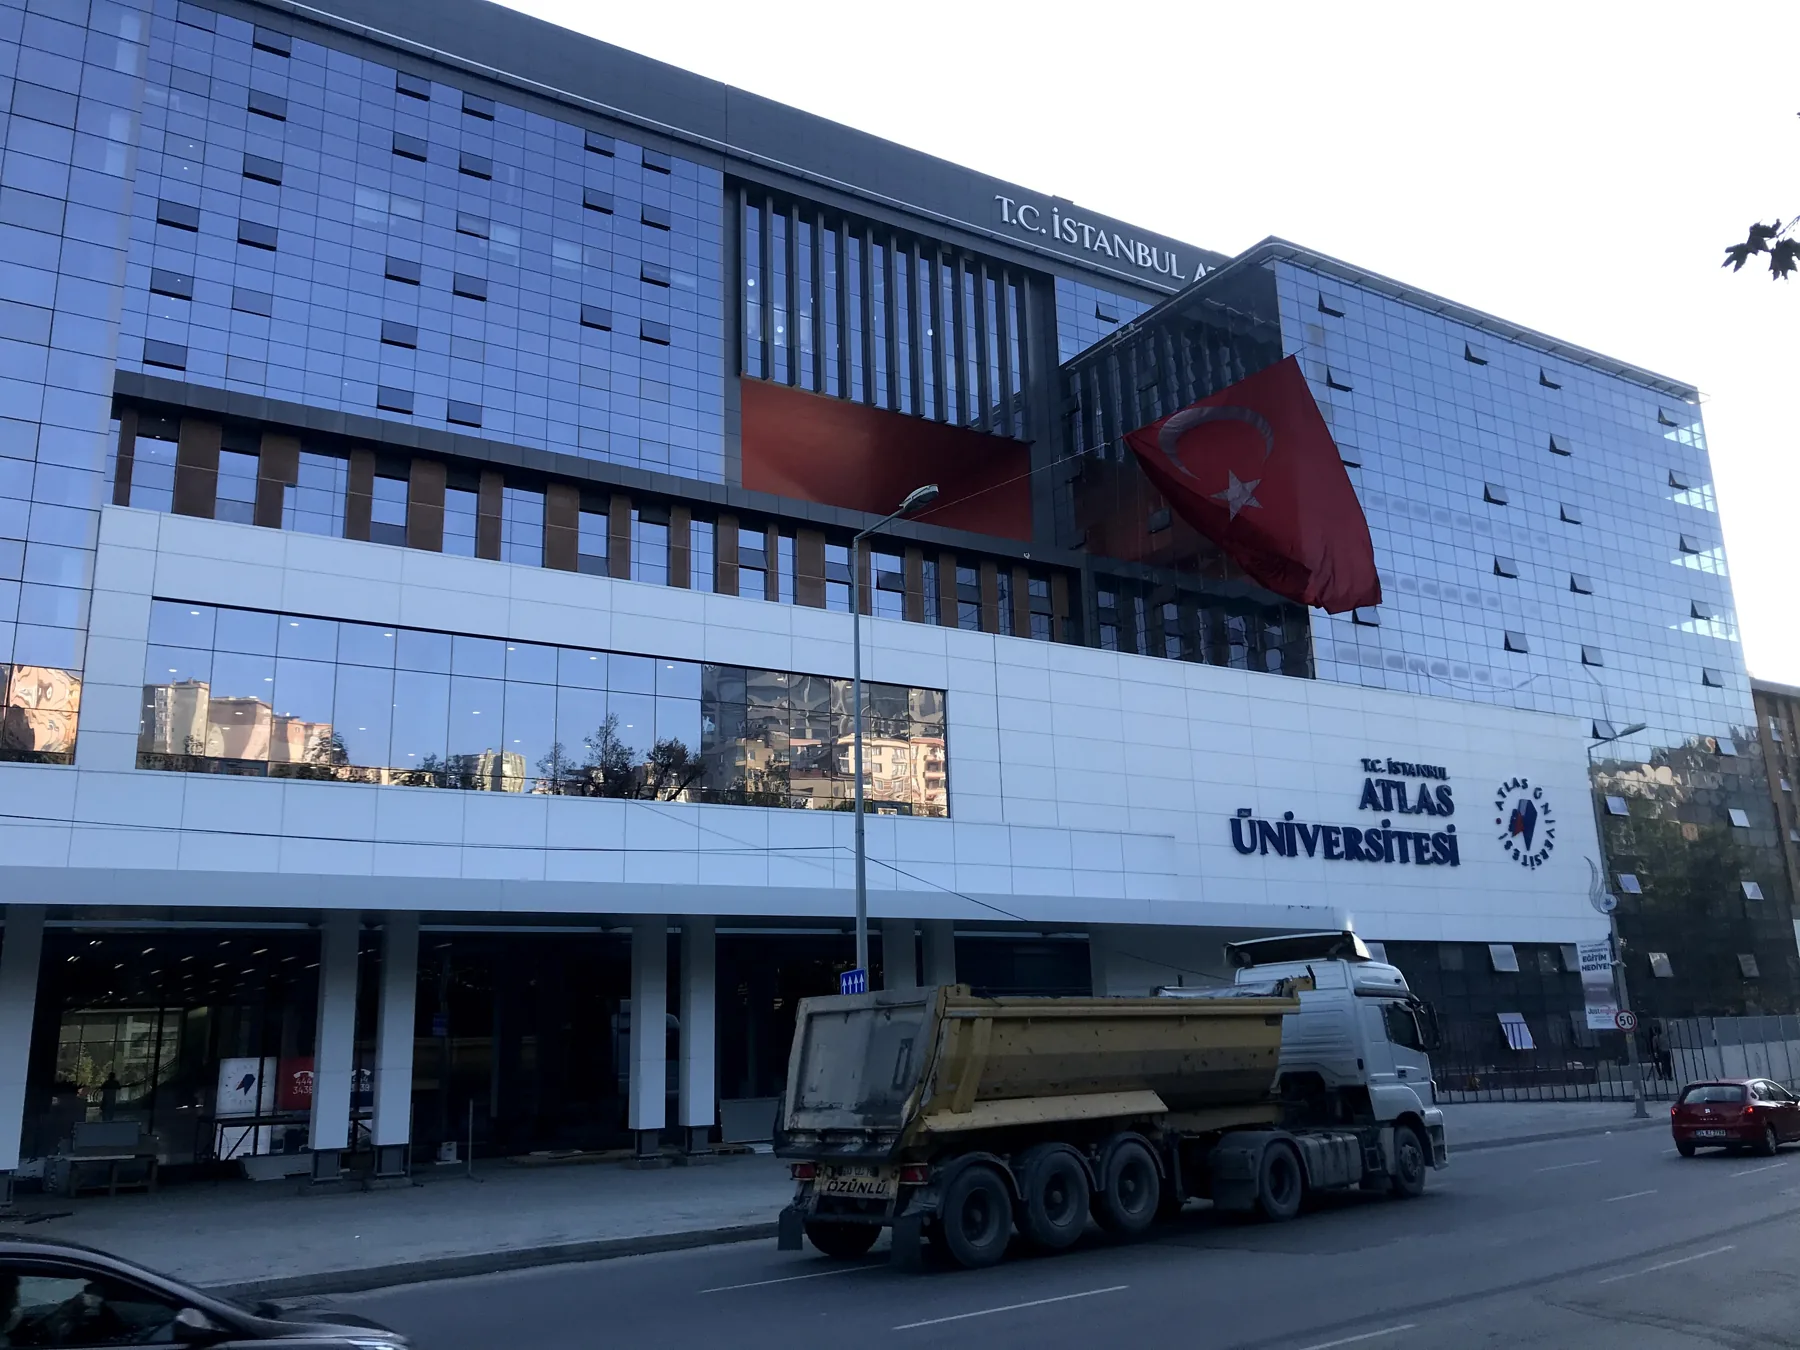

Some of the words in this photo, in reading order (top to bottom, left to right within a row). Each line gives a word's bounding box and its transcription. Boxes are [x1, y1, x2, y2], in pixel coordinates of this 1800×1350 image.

[994, 195, 1047, 234] T.C.
[1051, 207, 1186, 280] İSTANBUL
[1361, 758, 1386, 774] T.C.
[1387, 757, 1450, 780] İSTANBUL
[1358, 777, 1455, 817] ATLAS
[1495, 777, 1528, 811] ATLAS
[1229, 808, 1461, 867] ÜNİVERSİTESİ
[1619, 1015, 1633, 1026] 50
[826, 1178, 887, 1194] ÖZÜNLÜ
